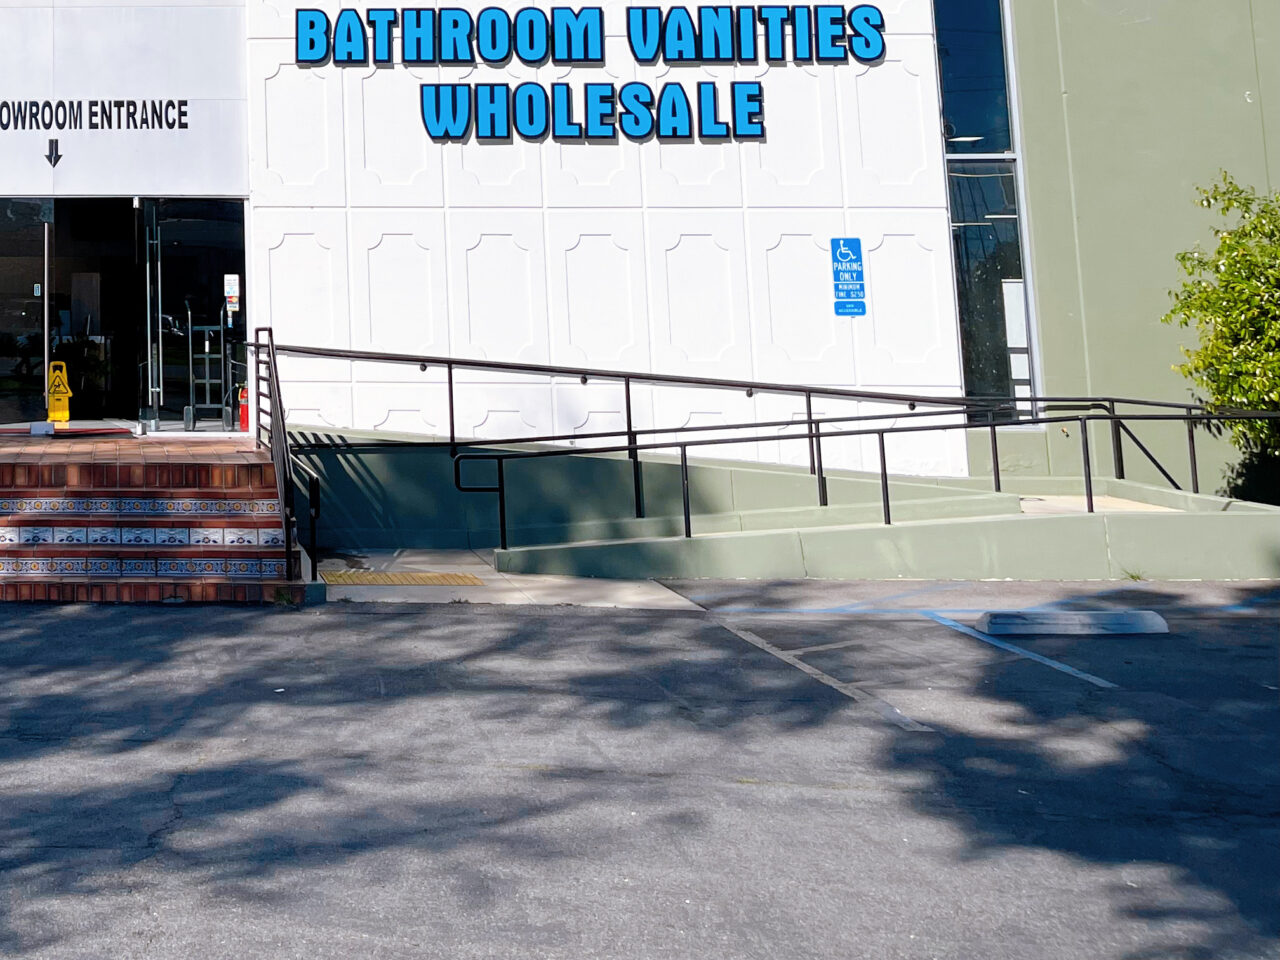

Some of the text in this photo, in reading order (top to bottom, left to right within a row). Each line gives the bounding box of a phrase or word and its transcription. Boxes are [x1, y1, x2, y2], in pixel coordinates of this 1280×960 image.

[295, 5, 887, 65] BATHROOM VANITIES
[88, 99, 189, 130] ENTRANCE
[420, 82, 766, 142] WHOLESALE
[833, 262, 863, 271] PARKING
[839, 272, 857, 281] ONLY
